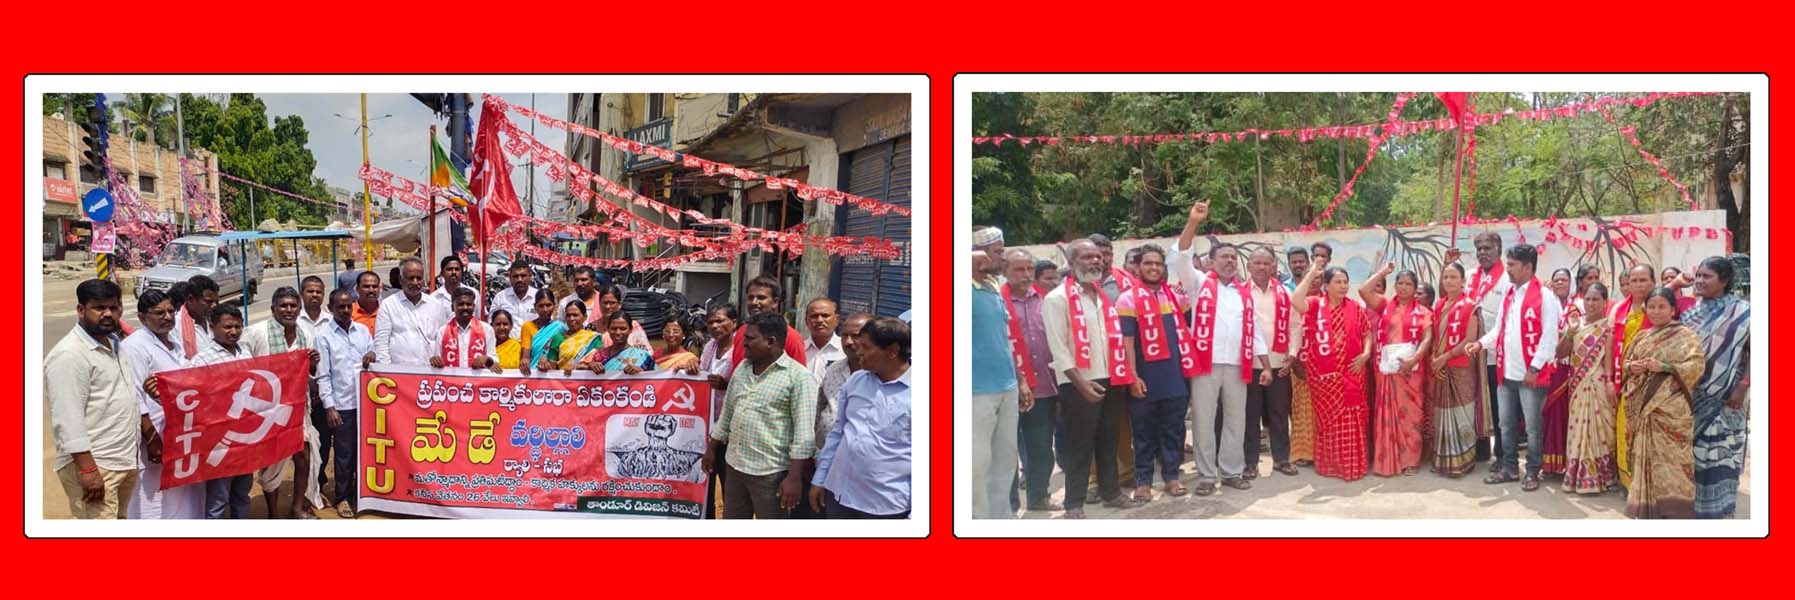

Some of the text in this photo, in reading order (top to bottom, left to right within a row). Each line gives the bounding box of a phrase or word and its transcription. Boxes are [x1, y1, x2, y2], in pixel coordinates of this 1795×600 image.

[1107, 306, 1126, 377] AITUC
[1137, 287, 1160, 356] AITUC
[1196, 287, 1213, 352] AITUC
[416, 379, 475, 409] ప్రపంచ
[479, 383, 572, 412] కార్మికులారా
[173, 389, 202, 479] CITU
[366, 376, 397, 494] CITU
[410, 410, 457, 463] మే
[467, 411, 501, 464] డే
[466, 493, 480, 502] 26
